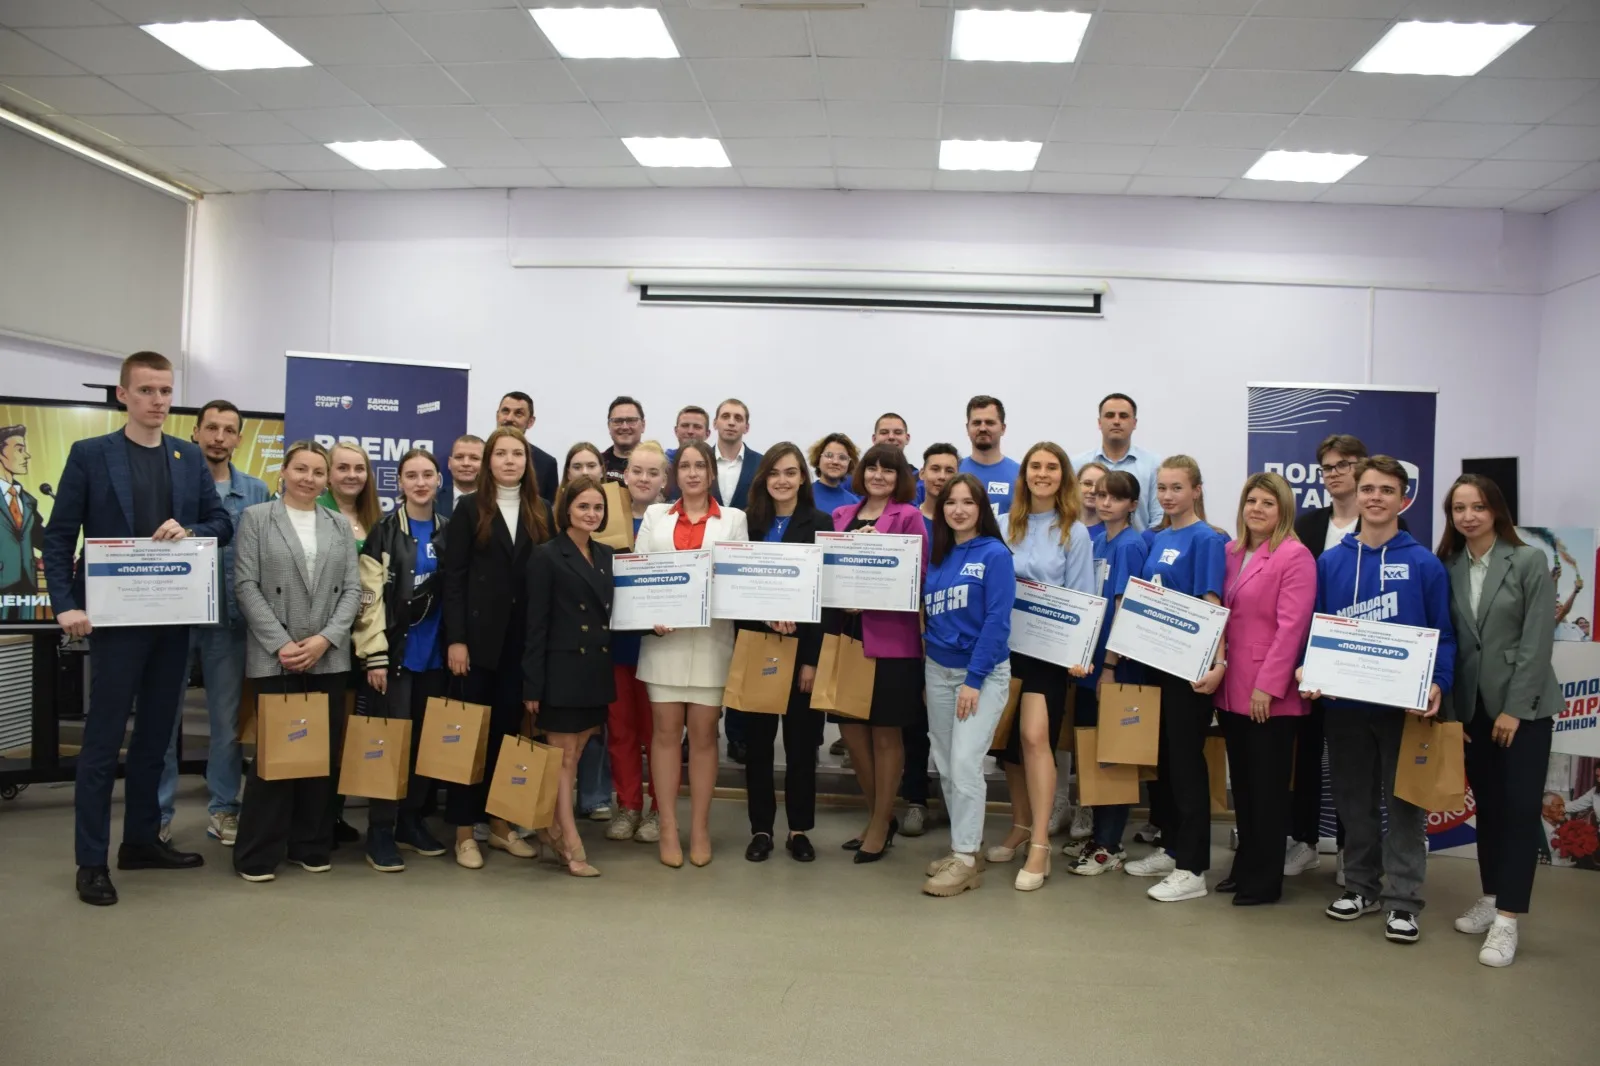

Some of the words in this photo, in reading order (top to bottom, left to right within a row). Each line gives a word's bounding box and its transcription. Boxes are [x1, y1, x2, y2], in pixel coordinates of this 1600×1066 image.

[367, 404, 399, 412] РОССИЯ
[1264, 462, 1325, 485] ПОЛ
[838, 556, 896, 565] «ПОЛИТСТАРТ»
[117, 564, 187, 573] «ПОЛИТСТАРТ»
[737, 566, 796, 575] «ПОЛИТСТАРТ»
[634, 575, 687, 584] «ПОЛИТСТАРТ»
[1028, 605, 1077, 623] «ПОЛИТСТАРТ»
[1143, 609, 1196, 631] «ПОЛИТСТАРТ»
[1337, 642, 1404, 657] «ПОЛИТСТАРТ»
[1559, 678, 1600, 698] ОЛО
[1553, 717, 1597, 732] ДИНОЙ
